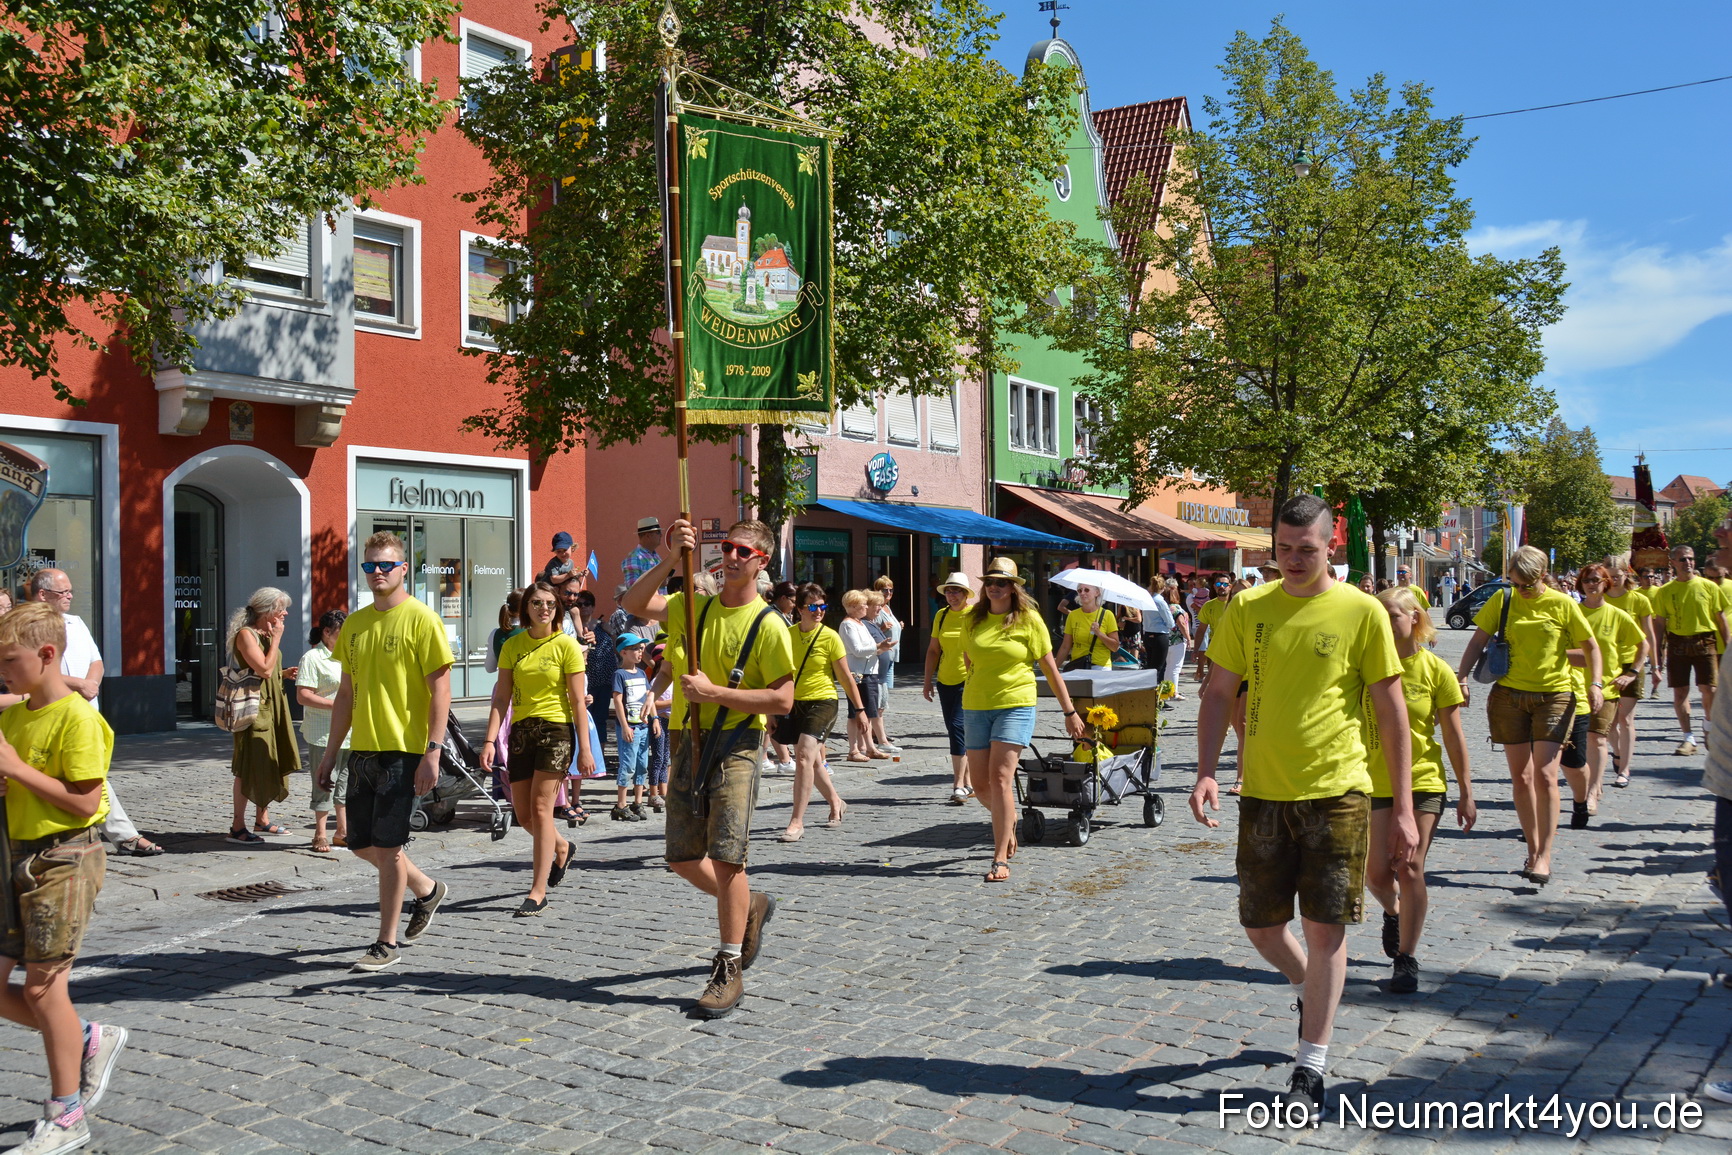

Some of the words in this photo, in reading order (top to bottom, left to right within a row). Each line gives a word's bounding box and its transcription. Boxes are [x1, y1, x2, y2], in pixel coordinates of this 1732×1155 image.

[708, 168, 795, 211] Sportschützenverein
[701, 305, 802, 344] WEIDENWANG
[725, 364, 744, 376] 1978
[751, 365, 771, 377] 2009
[867, 456, 885, 472] vom
[873, 464, 898, 488] FASS
[390, 477, 484, 509] fielmann
[1181, 501, 1205, 522] LEDER
[1208, 505, 1250, 526] ROMSTOCK
[421, 563, 455, 575] fielmann
[474, 564, 505, 575] fielmann
[1255, 622, 1265, 644] 2018
